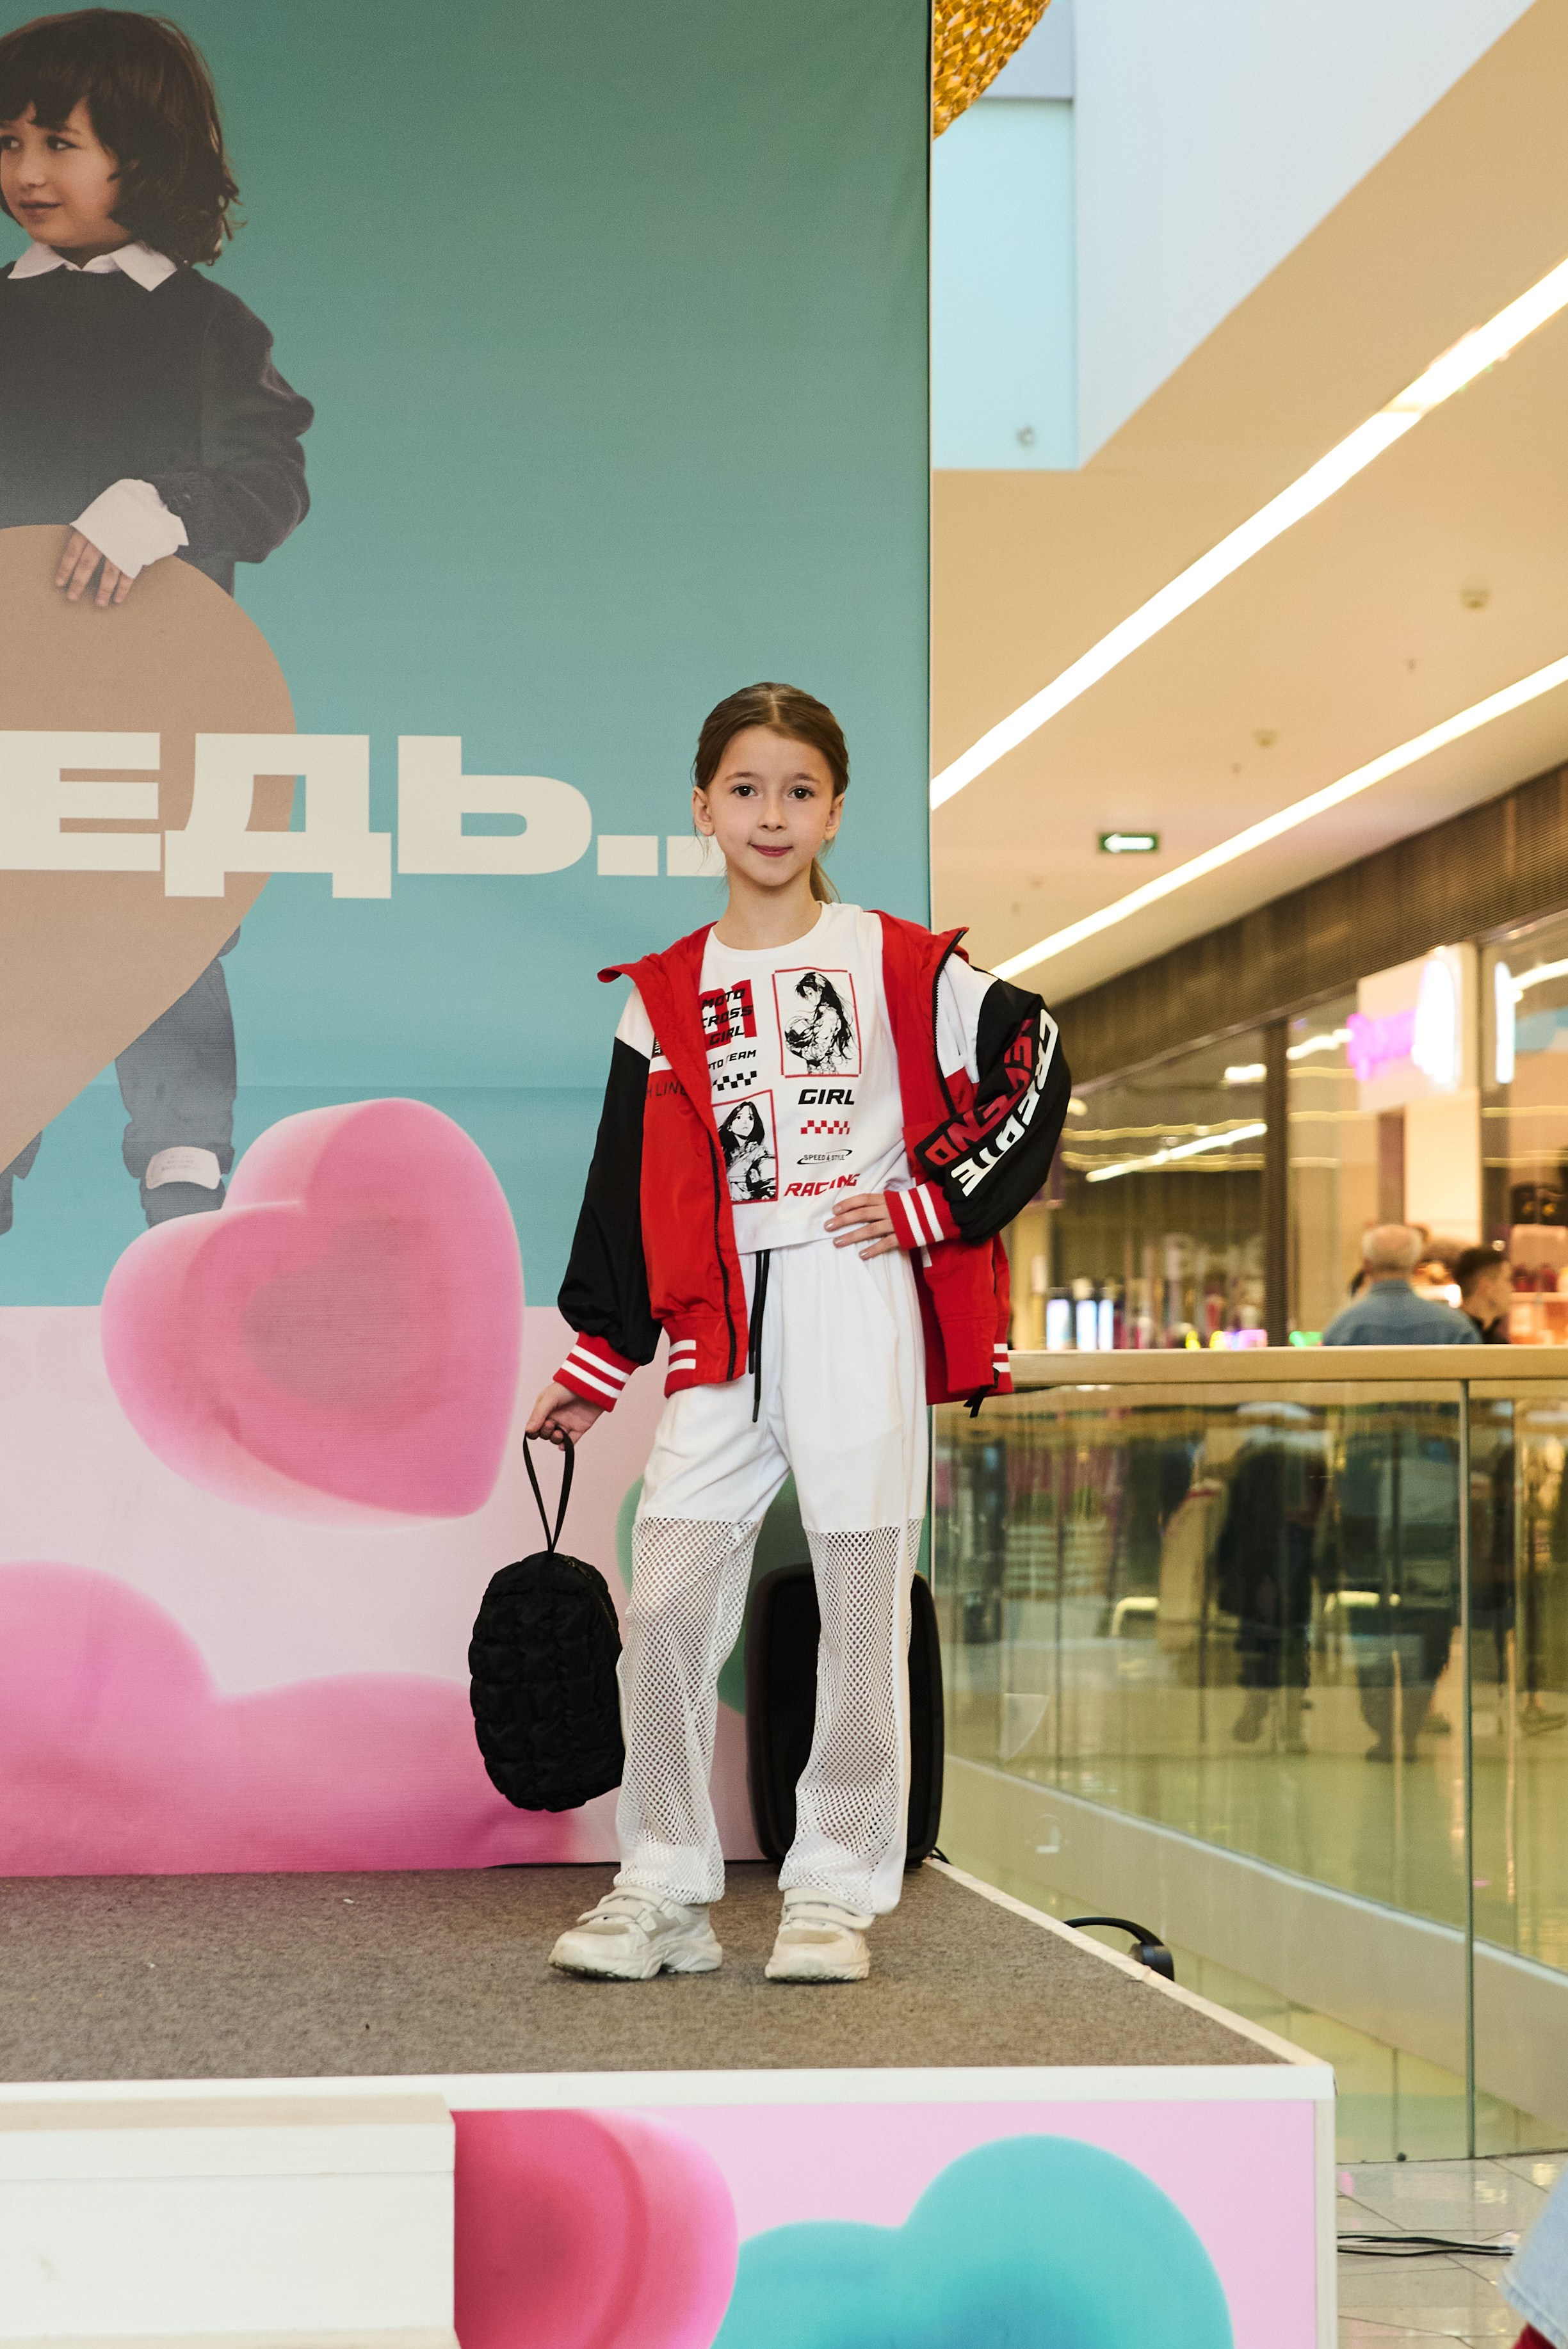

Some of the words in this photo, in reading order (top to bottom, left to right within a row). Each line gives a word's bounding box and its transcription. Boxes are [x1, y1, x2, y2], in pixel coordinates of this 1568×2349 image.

[701, 988, 745, 1010] MOTO
[709, 1026, 745, 1045] GIRL
[798, 1088, 855, 1105] GIRL
[925, 1018, 1035, 1166] EGEND
[784, 1173, 861, 1197] RACING
